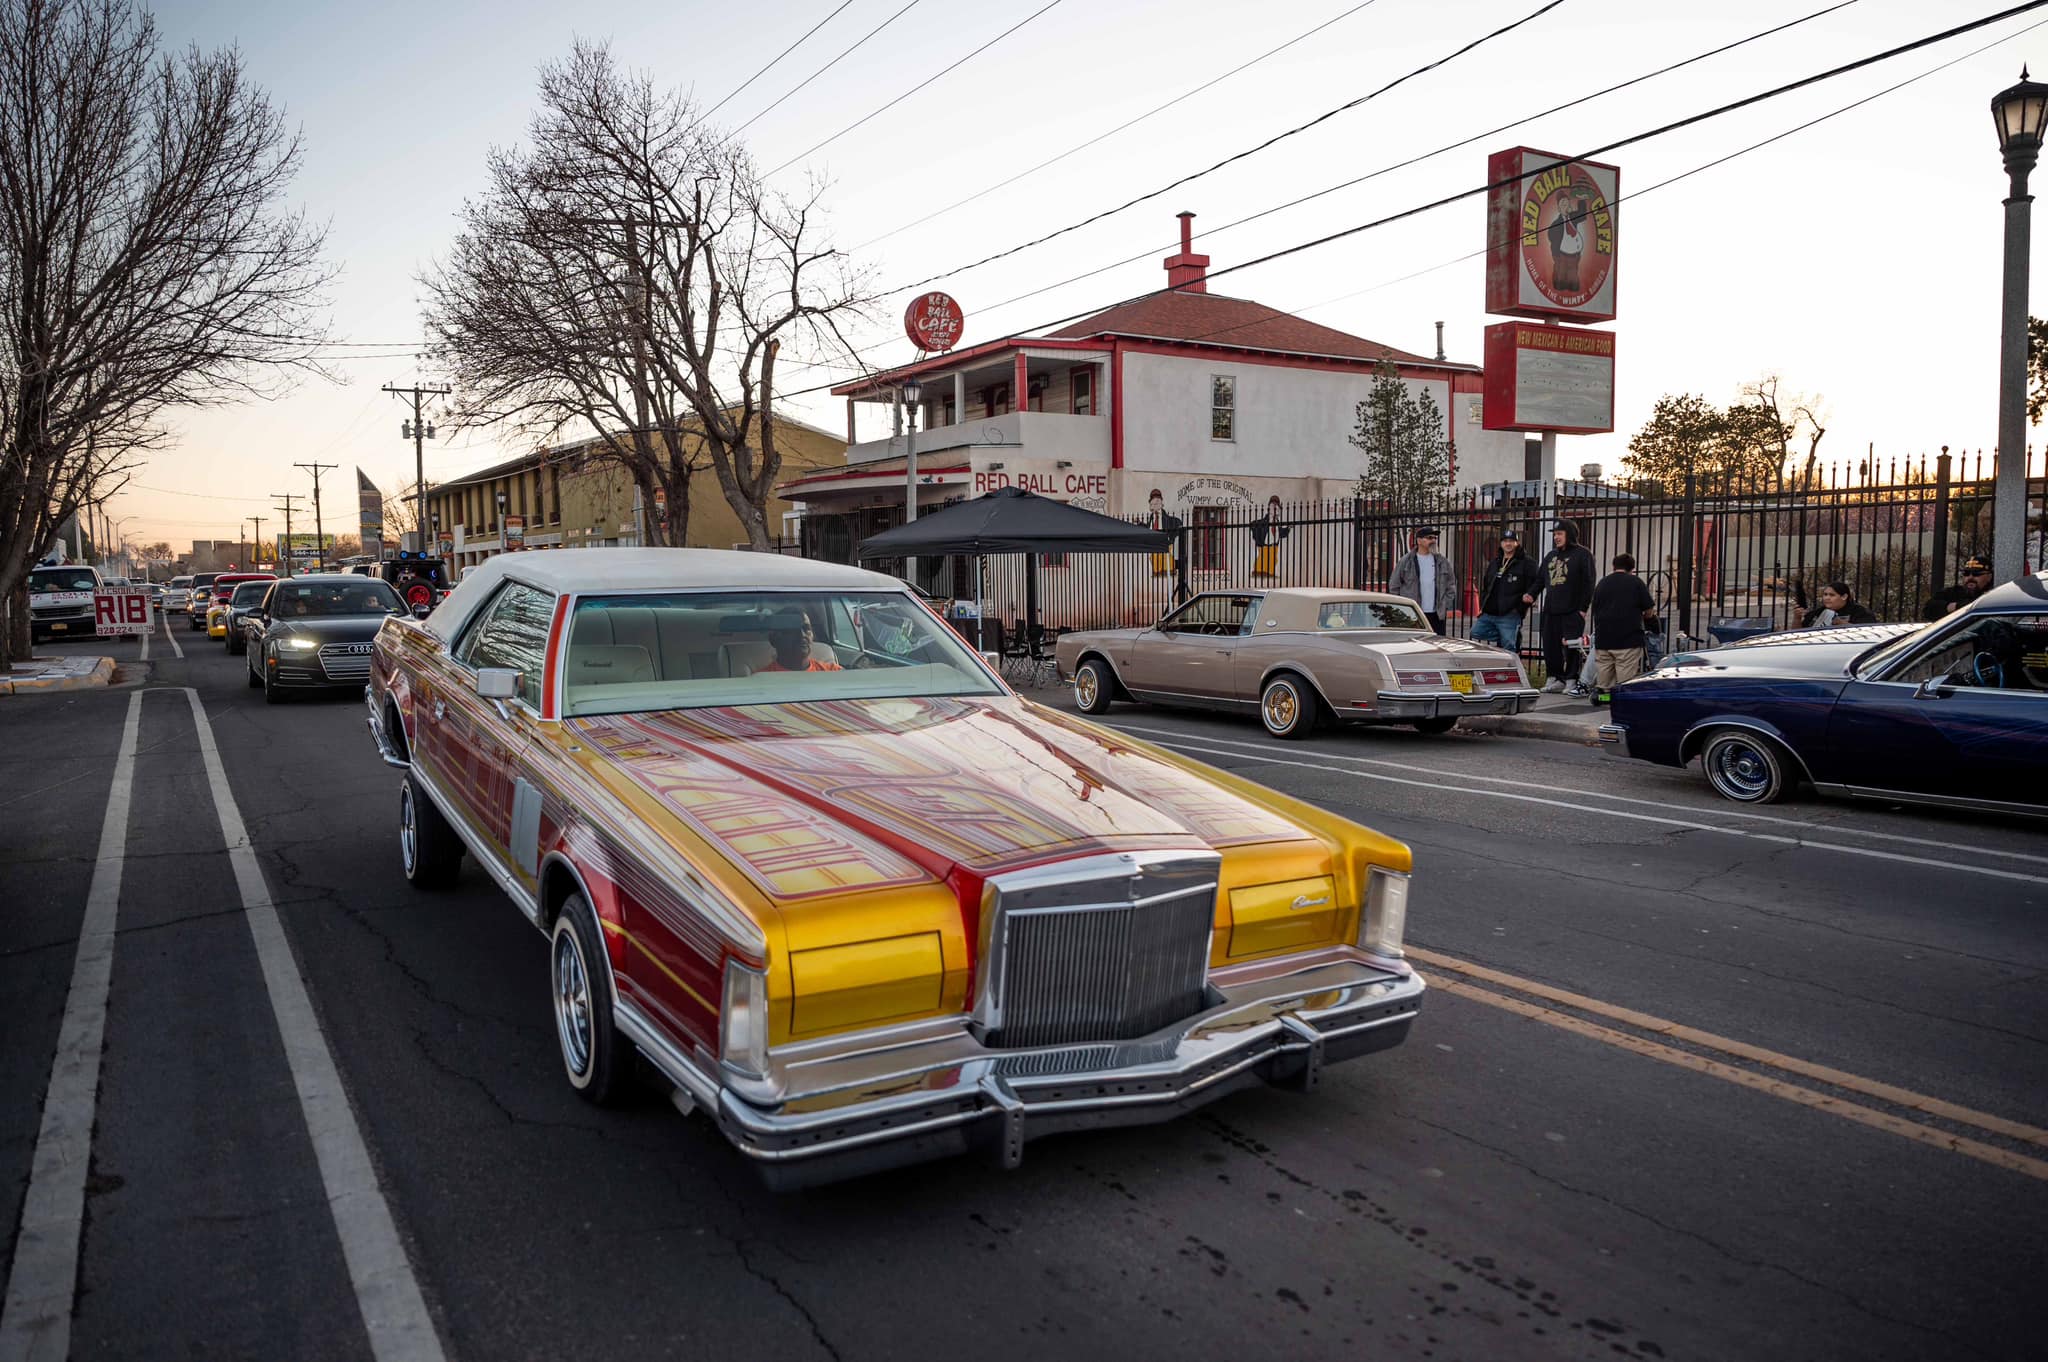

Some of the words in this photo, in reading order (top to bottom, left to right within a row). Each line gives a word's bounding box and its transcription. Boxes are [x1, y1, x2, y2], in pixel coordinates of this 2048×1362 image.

[1522, 200, 1540, 247] RED
[1533, 165, 1571, 203] BALL
[1591, 196, 1612, 255] CAFE
[1527, 258, 1540, 280] HOME
[1538, 280, 1546, 290] OF
[928, 294, 950, 306] RED
[928, 306, 950, 318] BALL
[918, 317, 959, 332] CAFE
[1517, 330, 1532, 345] NEW
[1532, 331, 1559, 348] MEXICAN
[1565, 336, 1595, 352] AMERICAN
[1595, 339, 1612, 353] FOOD
[975, 472, 1009, 493] RED
[1018, 474, 1057, 494] BALL
[1065, 474, 1106, 494] CAFE
[1177, 481, 1195, 501] HOME
[1197, 479, 1204, 488] OF
[1206, 479, 1221, 488] THE
[1223, 481, 1253, 504] ORIGINAL
[1187, 495, 1211, 505] WIMPY
[1216, 497, 1241, 506] CAFE
